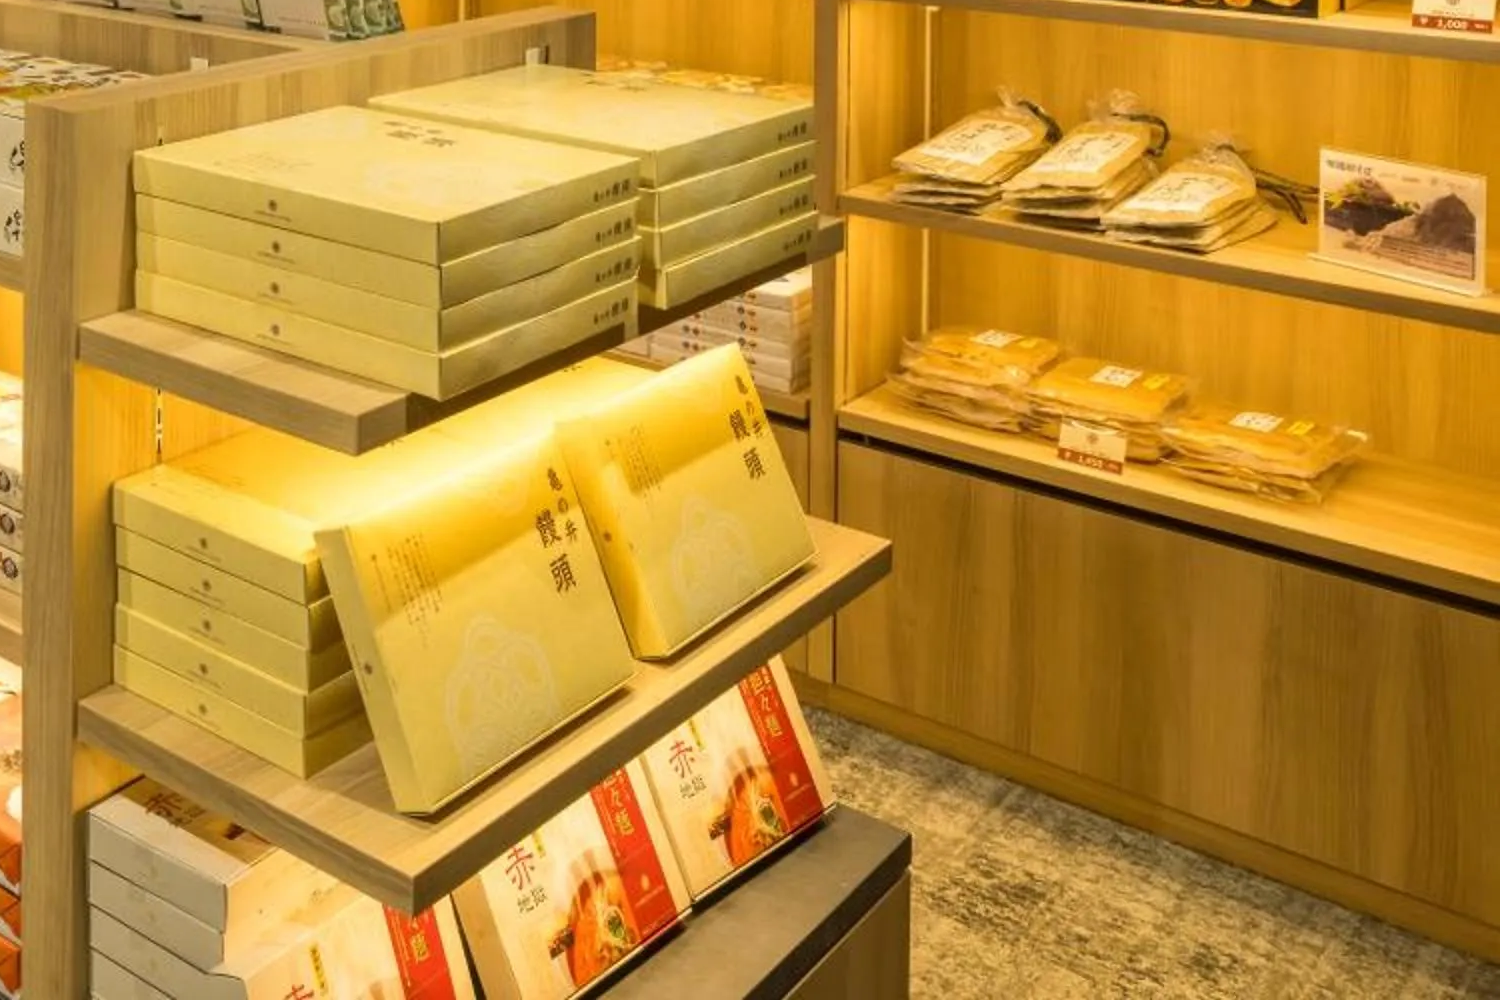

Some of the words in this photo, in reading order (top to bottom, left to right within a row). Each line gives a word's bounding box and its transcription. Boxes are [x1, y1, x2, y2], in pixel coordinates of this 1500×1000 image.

[546, 465, 580, 543] 亀の井
[534, 507, 578, 595] 饅頭
[668, 739, 696, 779] 赤
[504, 846, 535, 891] 赤
